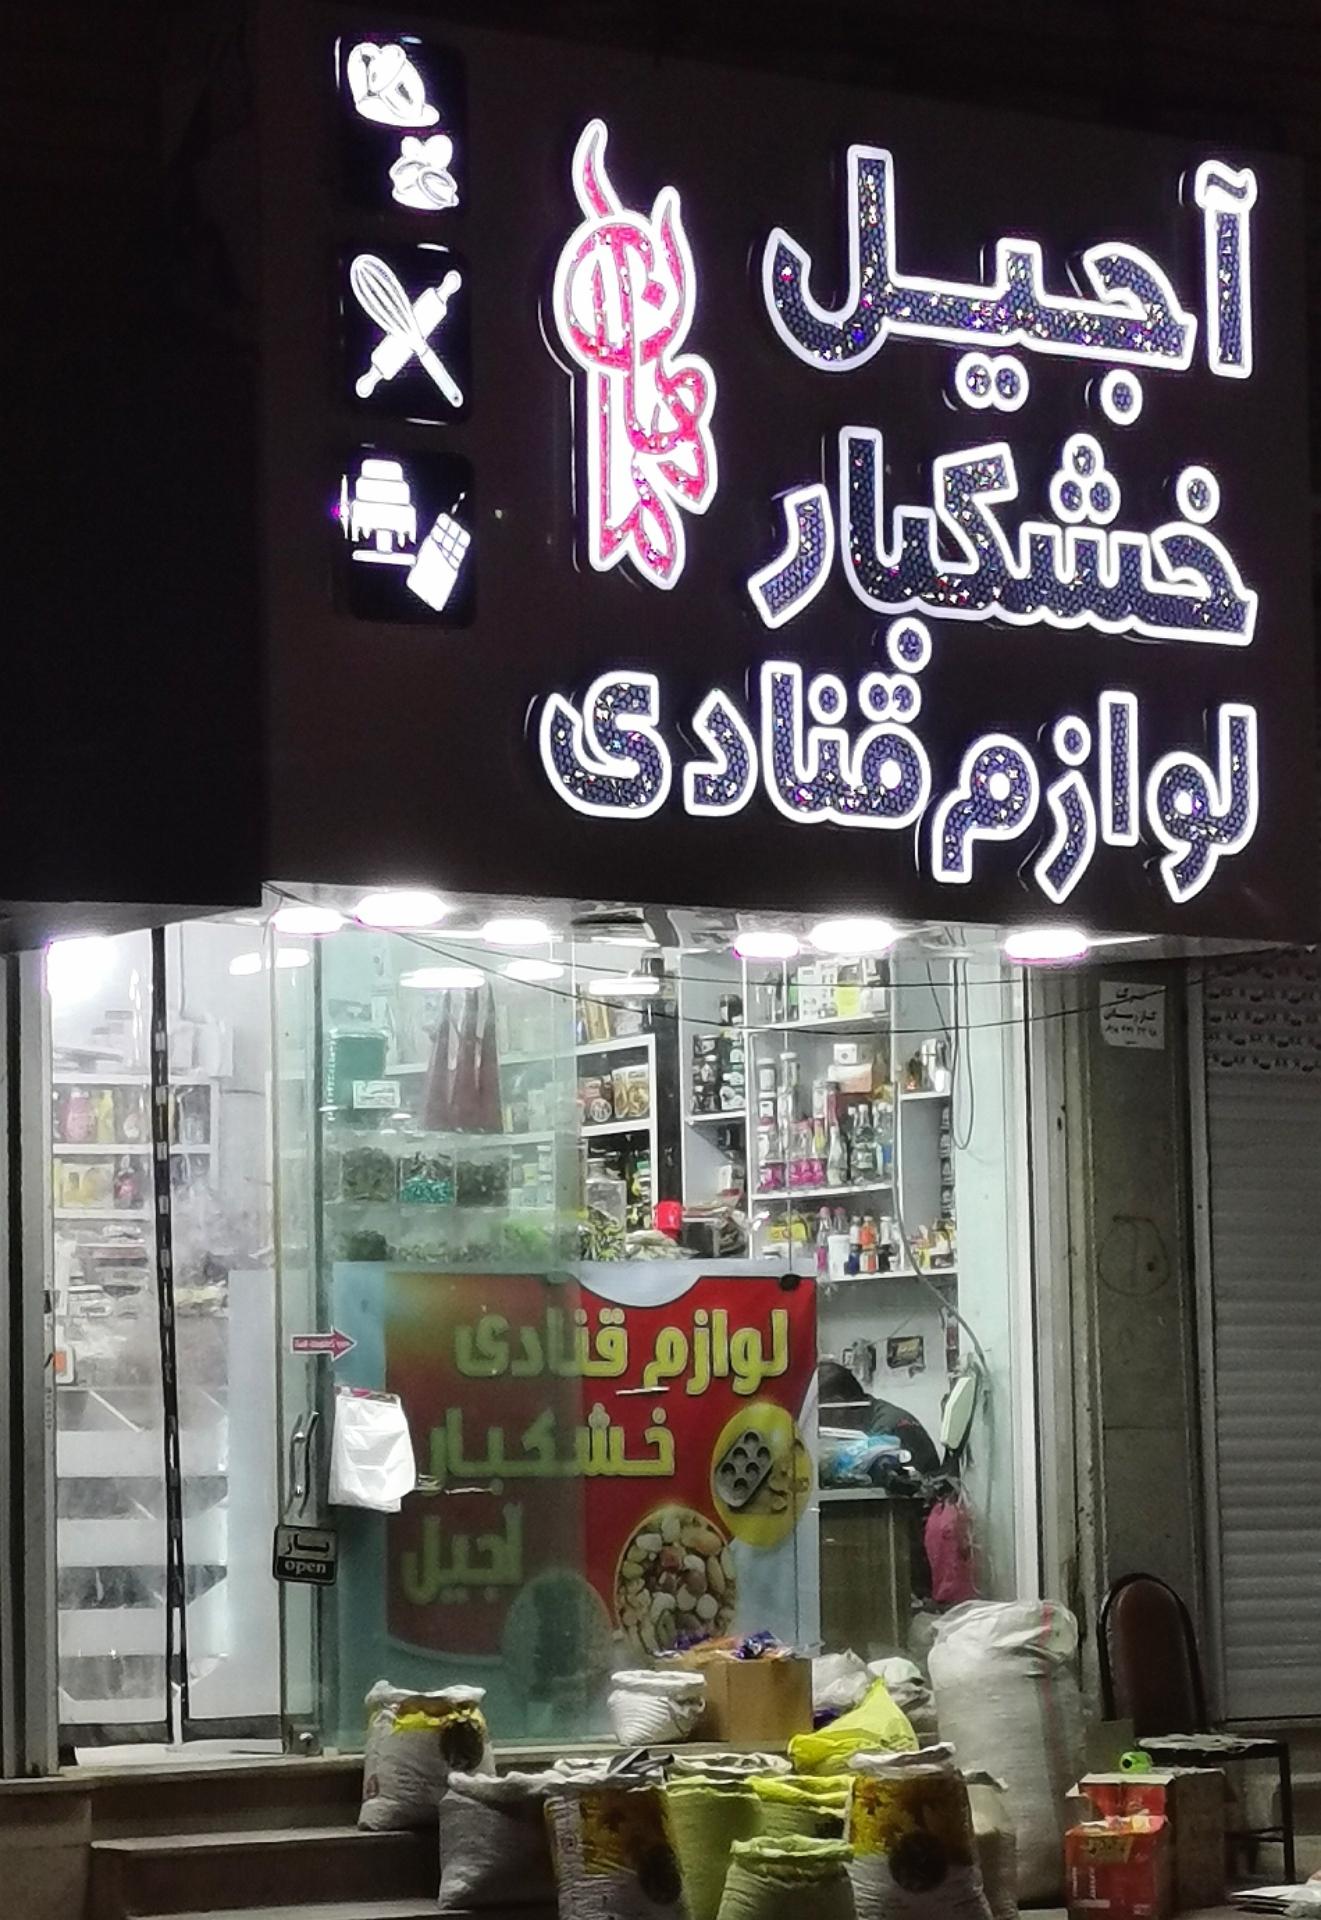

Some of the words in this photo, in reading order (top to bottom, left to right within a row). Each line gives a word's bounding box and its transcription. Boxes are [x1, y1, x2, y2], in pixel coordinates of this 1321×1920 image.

[763, 145, 1257, 424] آجیل
[748, 426, 1259, 671] خشکبار
[540, 660, 931, 828] قنادی
[933, 690, 1259, 904] لوازم
[454, 1306, 628, 1379] قنادی
[642, 1308, 789, 1396] لوازم
[430, 1403, 675, 1493] خشکبار
[284, 1560, 327, 1575] open
